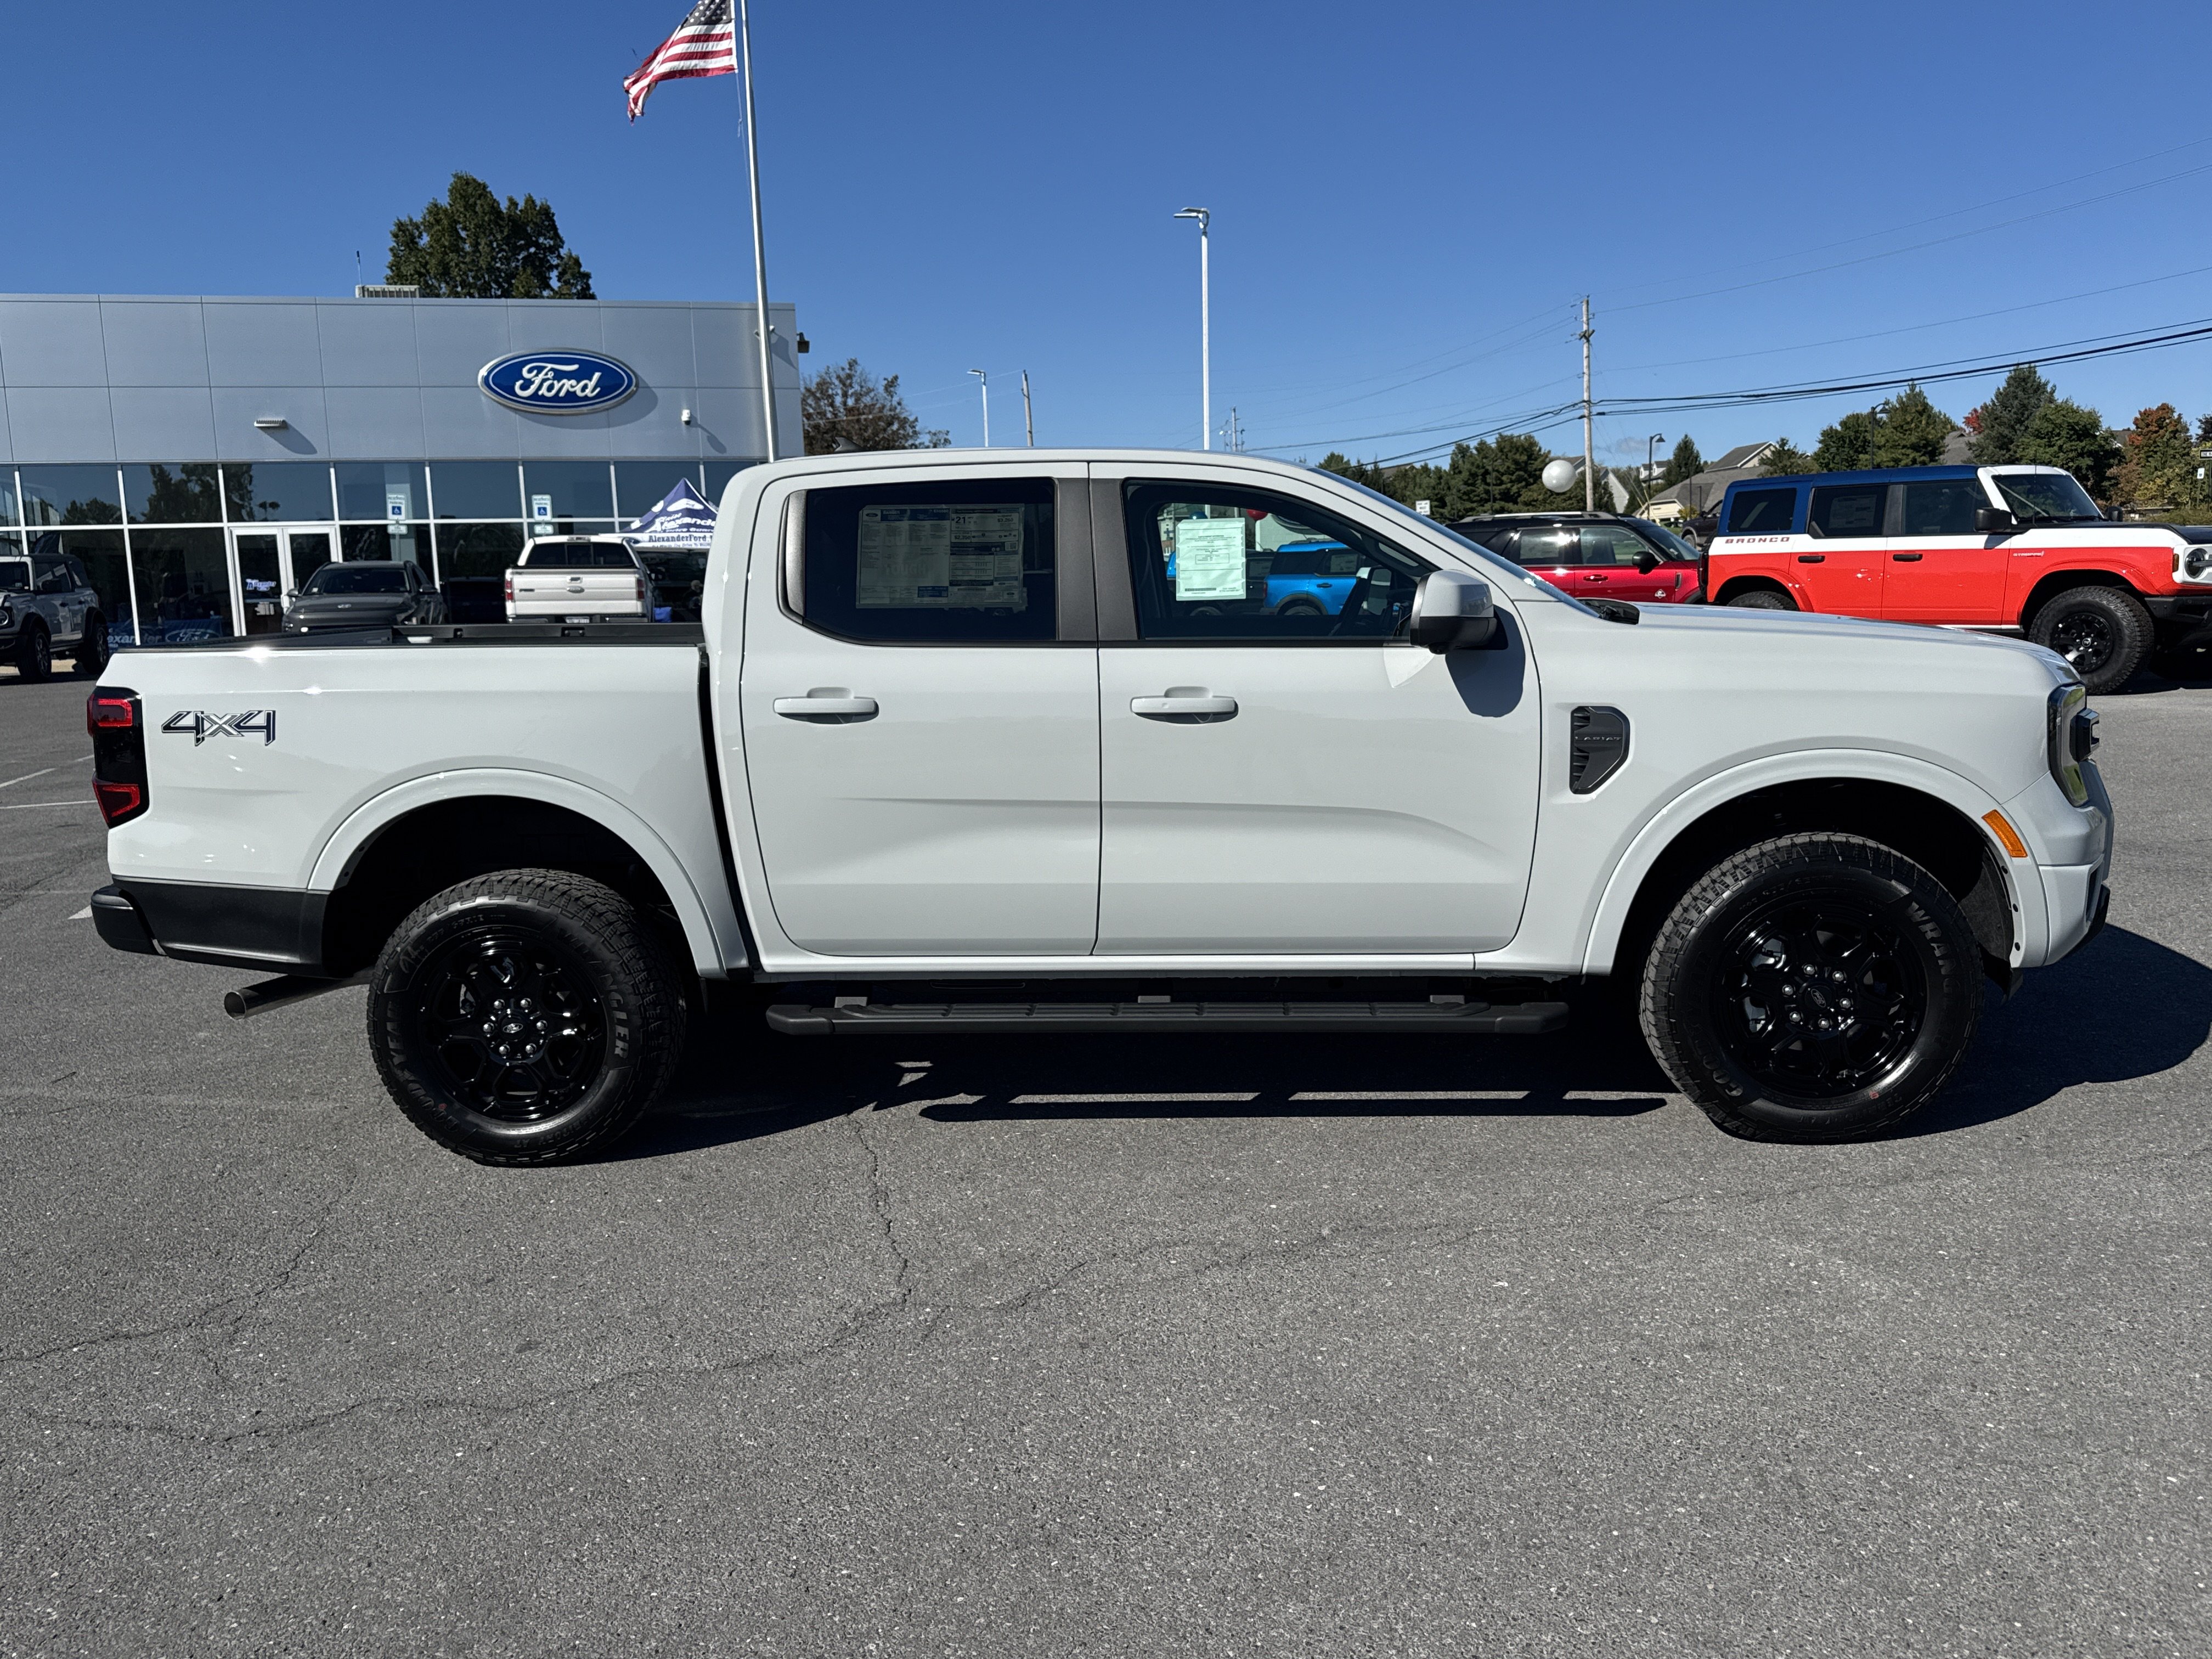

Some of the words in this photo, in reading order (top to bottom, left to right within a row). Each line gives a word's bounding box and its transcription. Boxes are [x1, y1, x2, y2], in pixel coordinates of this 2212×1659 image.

[515, 363, 602, 398] Ford
[645, 517, 716, 533] Alexande
[386, 1000, 460, 1133] GOODYEAR
